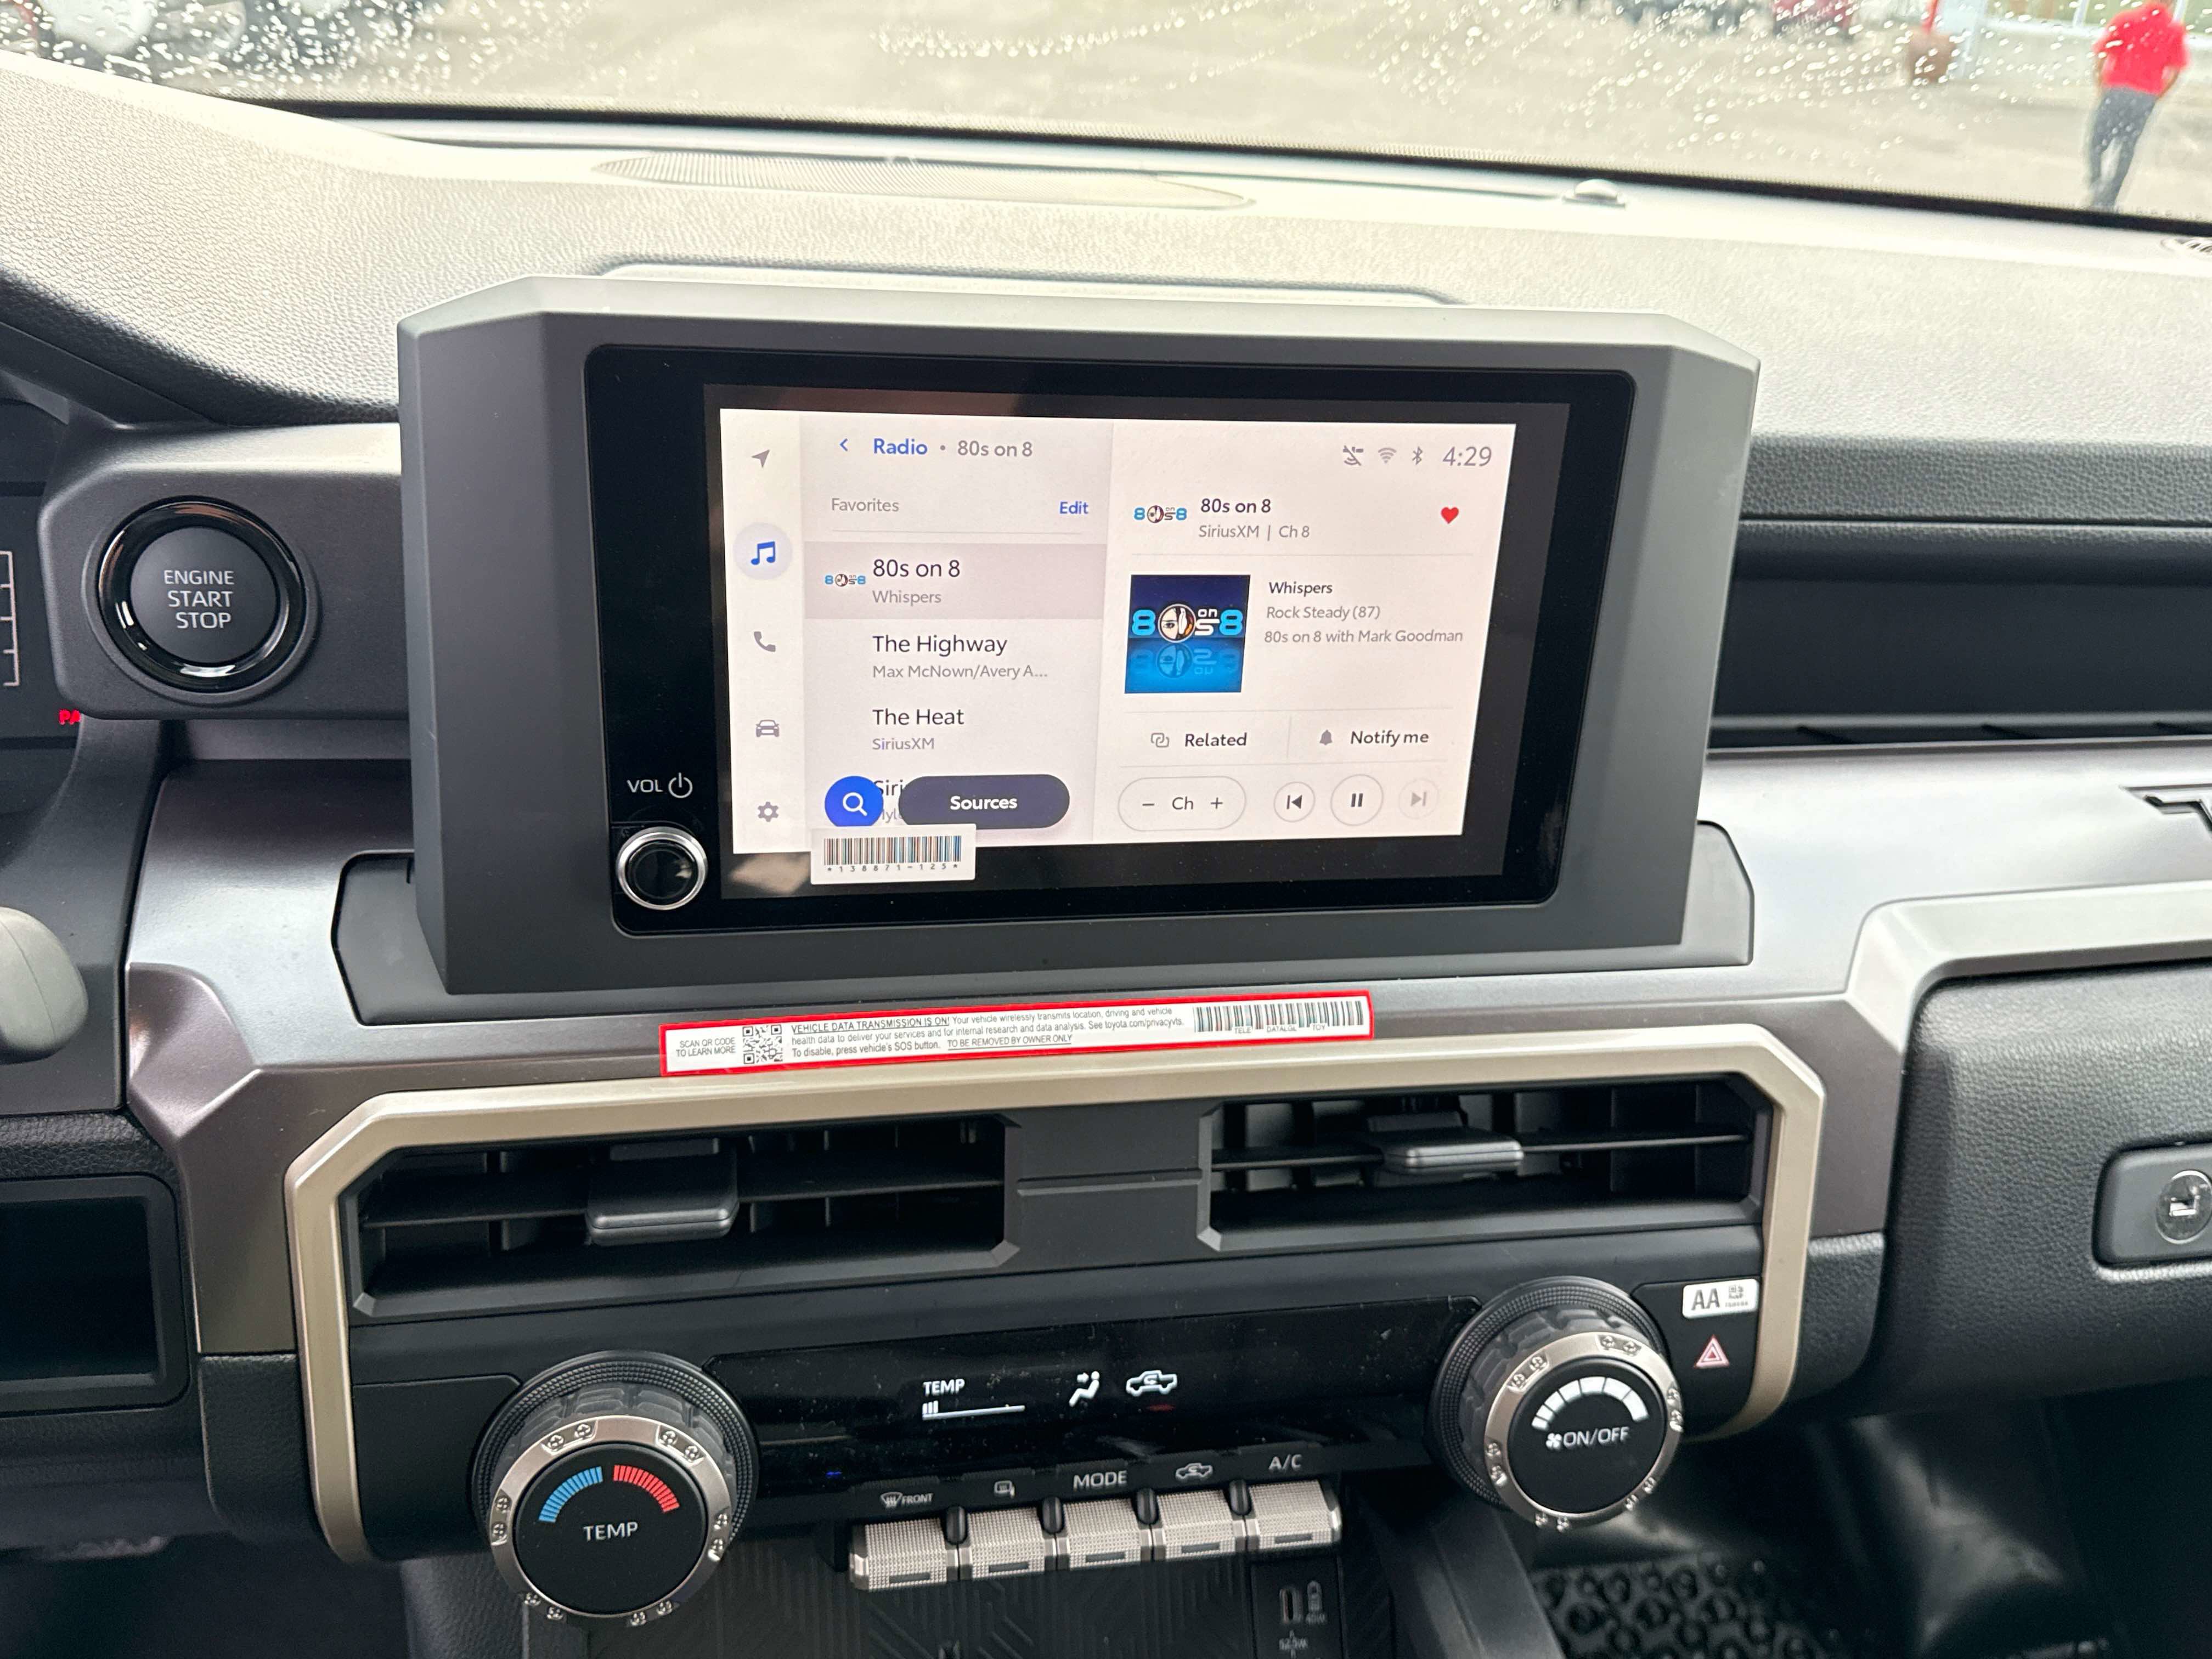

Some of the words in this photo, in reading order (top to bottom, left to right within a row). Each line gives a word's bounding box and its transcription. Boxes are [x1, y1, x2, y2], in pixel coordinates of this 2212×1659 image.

[873, 438, 928, 456] Radio
[957, 442, 989, 458] 80s
[994, 444, 1018, 458] on
[1022, 442, 1034, 458] 8
[1443, 446, 1492, 467] 4:29
[831, 498, 900, 512] Favorites
[1059, 501, 1089, 515] Edit
[1200, 499, 1230, 514] 80s
[1236, 502, 1257, 514] on
[1261, 499, 1272, 514] 8
[1199, 525, 1260, 539] SiriusXM
[1279, 526, 1299, 539] Ch
[1301, 526, 1310, 539] 8
[873, 558, 910, 578] 80s
[916, 563, 943, 578] on
[948, 559, 961, 578] 8
[163, 569, 235, 585] ENGINE
[1268, 582, 1333, 597] Whispers
[167, 590, 234, 608] START
[872, 590, 942, 606] Whispers
[176, 612, 232, 629] STOP
[1266, 606, 1299, 619] Rock
[1303, 606, 1350, 621] Steady
[1352, 605, 1381, 620] (87)
[1219, 609, 1244, 636] 8
[1264, 630, 1287, 643] 80s
[1290, 633, 1310, 643] on
[1313, 630, 1322, 643] 8
[1325, 630, 1355, 642] with
[1358, 629, 1392, 642] Mark
[1395, 629, 1463, 642] Goodman
[873, 635, 910, 652] The
[917, 635, 1008, 657] Highway
[873, 665, 904, 678] Max
[908, 664, 1020, 680] McNown/Avery
[873, 709, 910, 725] The
[916, 709, 965, 725] Heat
[872, 737, 935, 751] SiriusXM
[1184, 732, 1248, 747] Related
[1350, 730, 1401, 747] Notify
[1403, 733, 1429, 744] me
[627, 779, 663, 793] VOL
[950, 795, 1018, 810] Sources
[1172, 796, 1194, 811] Ch
[791, 1023, 829, 1034] VEHICLE
[832, 1022, 854, 1031] DATA
[856, 1018, 922, 1030] TRANSMISSION
[924, 1017, 932, 1026] IS
[952, 1015, 969, 1024] Your
[971, 1014, 997, 1023] vehicle
[999, 1013, 1035, 1023] wirelessly
[1037, 1011, 1070, 1021] transmits
[1073, 1010, 1104, 1019] location,
[1105, 1009, 1129, 1018] driving
[1131, 1008, 1145, 1016] and
[1147, 1007, 1172, 1015] vehicle
[792, 1035, 816, 1045] health
[817, 1034, 835, 1043] data
[837, 1034, 845, 1042] to
[848, 1032, 872, 1042] deliver
[875, 1032, 891, 1042] your
[894, 1030, 925, 1039] services
[927, 1028, 941, 1037] and
[943, 1028, 953, 1036] for
[956, 1026, 984, 1036] internal
[985, 1025, 1018, 1034] research
[1020, 1024, 1034, 1032] and
[1036, 1023, 1052, 1032] data
[1088, 1020, 1103, 1030] See
[680, 1040, 700, 1048] SCAN
[702, 1039, 713, 1047] QR
[714, 1037, 736, 1046] CODE
[792, 1048, 802, 1057] To
[803, 1046, 834, 1056] disable,
[836, 1046, 857, 1056] press
[859, 1042, 892, 1053] vehicle's
[894, 1041, 912, 1051] SOS
[947, 1039, 957, 1048] TO
[960, 1038, 969, 1047] BE
[971, 1036, 1009, 1046] REMOVED
[1011, 1035, 1021, 1044] BY
[1022, 1034, 1052, 1044] OWNER
[1052, 1033, 1073, 1042] ONLY
[676, 1048, 686, 1057] TO
[688, 1047, 712, 1057] LEARN
[714, 1046, 736, 1054] MORE
[1691, 1288, 1720, 1311] AA
[923, 1378, 966, 1396] TEMP
[1562, 1426, 1630, 1447] ON/OFF
[1268, 1454, 1302, 1472] A/C
[1073, 1470, 1128, 1489] MODE
[901, 1492, 934, 1505] FRONT
[583, 1521, 639, 1541] TEMP
